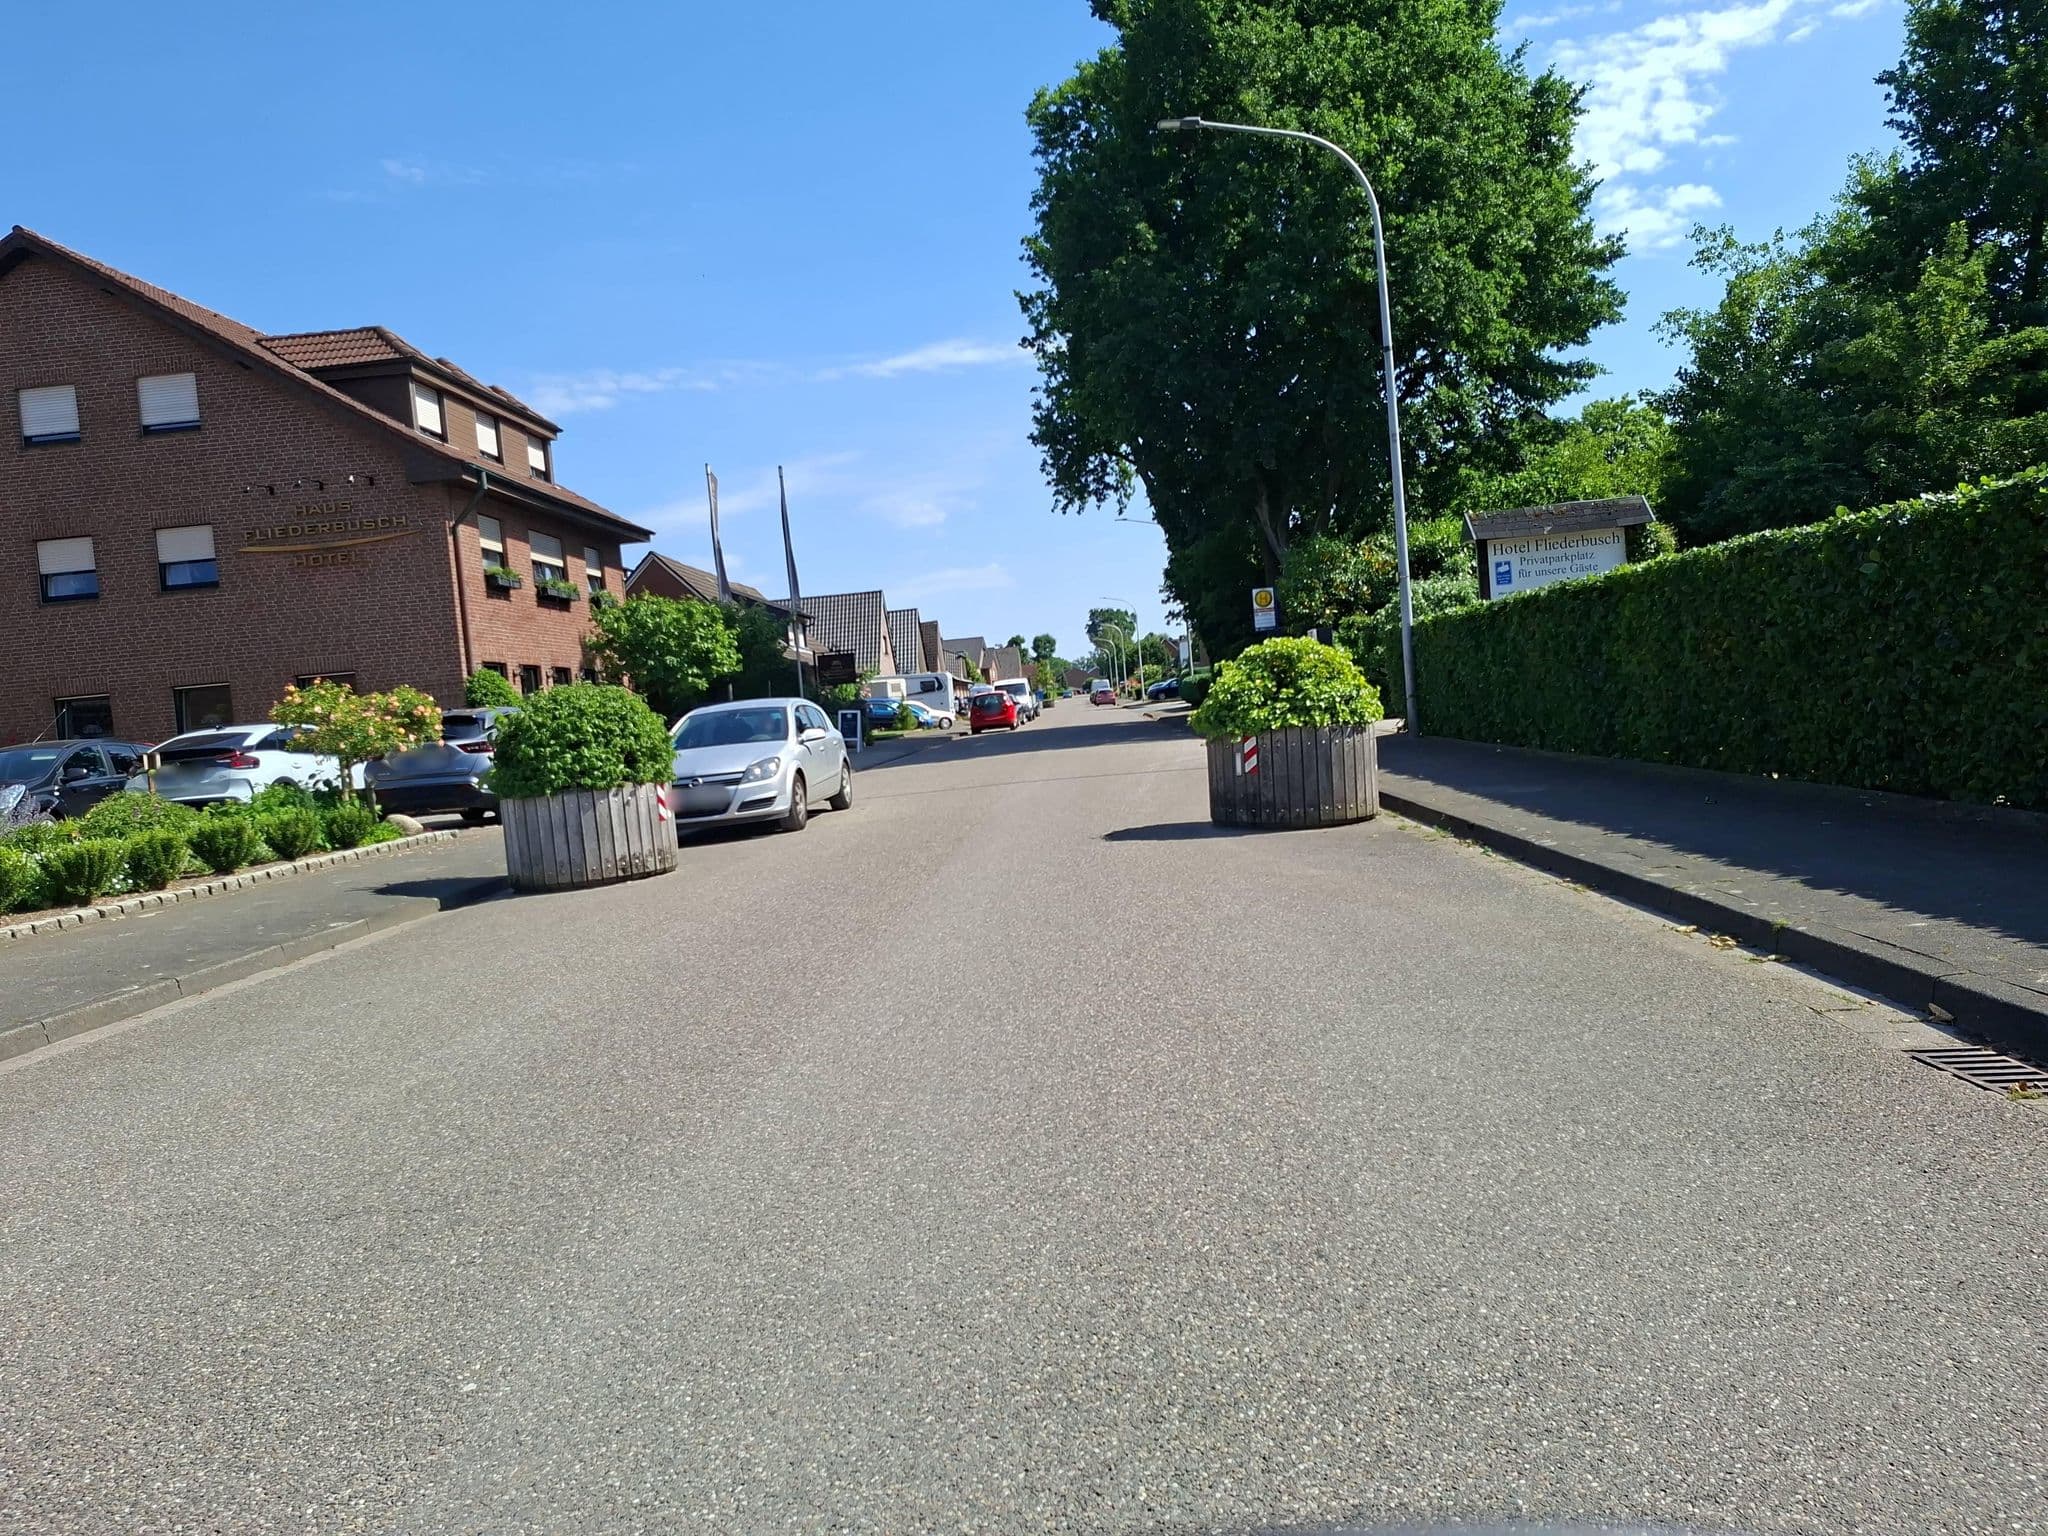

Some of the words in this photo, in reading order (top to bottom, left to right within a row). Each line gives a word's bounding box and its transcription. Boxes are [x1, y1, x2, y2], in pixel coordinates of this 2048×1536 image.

[295, 502, 352, 516] HAUS
[244, 516, 407, 540] FLIEDERBUSCH
[1493, 541, 1531, 556] Hotel
[1535, 532, 1620, 552] Fliederbusch
[295, 552, 360, 567] HOTEL
[1520, 551, 1596, 566] Privatparkplatz
[1518, 568, 1531, 578] für
[1536, 566, 1567, 576] unsere
[1570, 563, 1599, 573] Gäste
